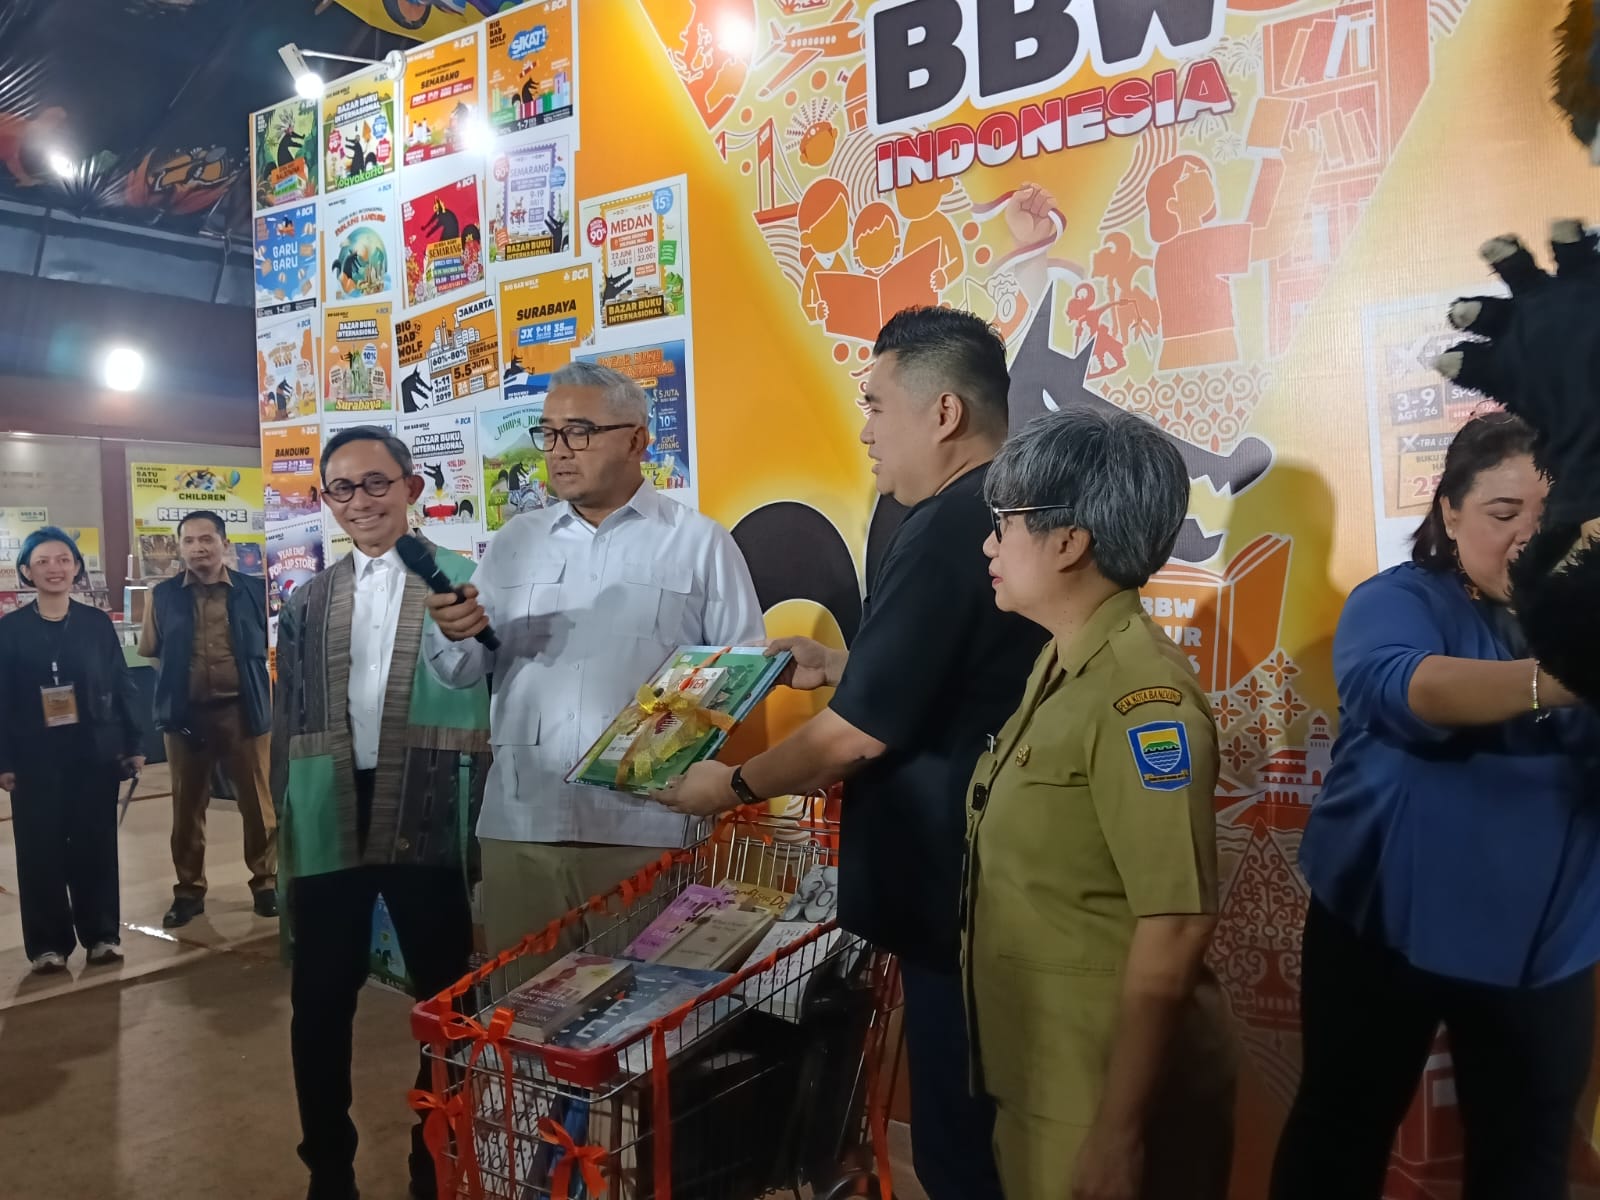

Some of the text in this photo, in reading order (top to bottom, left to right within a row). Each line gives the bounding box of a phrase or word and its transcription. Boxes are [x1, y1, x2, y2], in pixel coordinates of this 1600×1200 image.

[489, 20, 500, 30] BIG
[489, 27, 503, 38] BAD
[489, 33, 507, 45] WOLF
[511, 27, 546, 55] SIKAT!
[873, 0, 1214, 126] BBW
[420, 70, 460, 90] SEMARANG
[875, 58, 1235, 194] INDONESIA
[333, 165, 385, 188] Yogyakarta
[510, 163, 550, 177] SEMARANG
[610, 212, 653, 235] MEDAN
[428, 244, 462, 257] SEMARANG
[506, 239, 551, 254] BAZAR BUKU
[506, 248, 552, 260] INTERNASIONAL
[571, 268, 589, 281] BCA
[458, 298, 494, 318] JAKARTA
[516, 298, 577, 321] SURABAYA
[608, 297, 662, 315] BAZAR BUKU
[608, 307, 663, 324] INTERNASIONAL
[339, 320, 376, 331] BAZAR BUKU
[395, 320, 411, 334] BIG
[553, 322, 565, 333] 35
[337, 329, 379, 337] INTERNASIONAL
[396, 331, 416, 346] BAD
[520, 327, 533, 339] JX
[397, 340, 423, 358] WOLF
[363, 352, 377, 361] 10%
[432, 350, 467, 366] 60%-80%
[454, 361, 473, 379] 5.5
[472, 357, 490, 369] JUTA
[434, 375, 450, 387] 1-11
[434, 384, 451, 394] MARET
[436, 391, 452, 402] 2019
[1396, 387, 1436, 412] 3-9
[336, 398, 382, 411] Surabaya
[1420, 406, 1438, 418] '26
[460, 416, 471, 425] BCA
[415, 431, 460, 446] BAZAR BUKU
[656, 440, 680, 451] GUDANG
[1401, 433, 1437, 453] X-TRA
[275, 446, 310, 458] BANDUNG
[412, 441, 464, 454] INTERNASIONAL
[179, 492, 226, 501] CHILDREN
[157, 507, 248, 522] REFNCE
[277, 548, 292, 561] YEAR
[268, 555, 316, 580] POP-UP STORE
[1139, 596, 1196, 618] BBW
[1163, 625, 1202, 647] UR
[517, 1010, 552, 1024] QUINN
